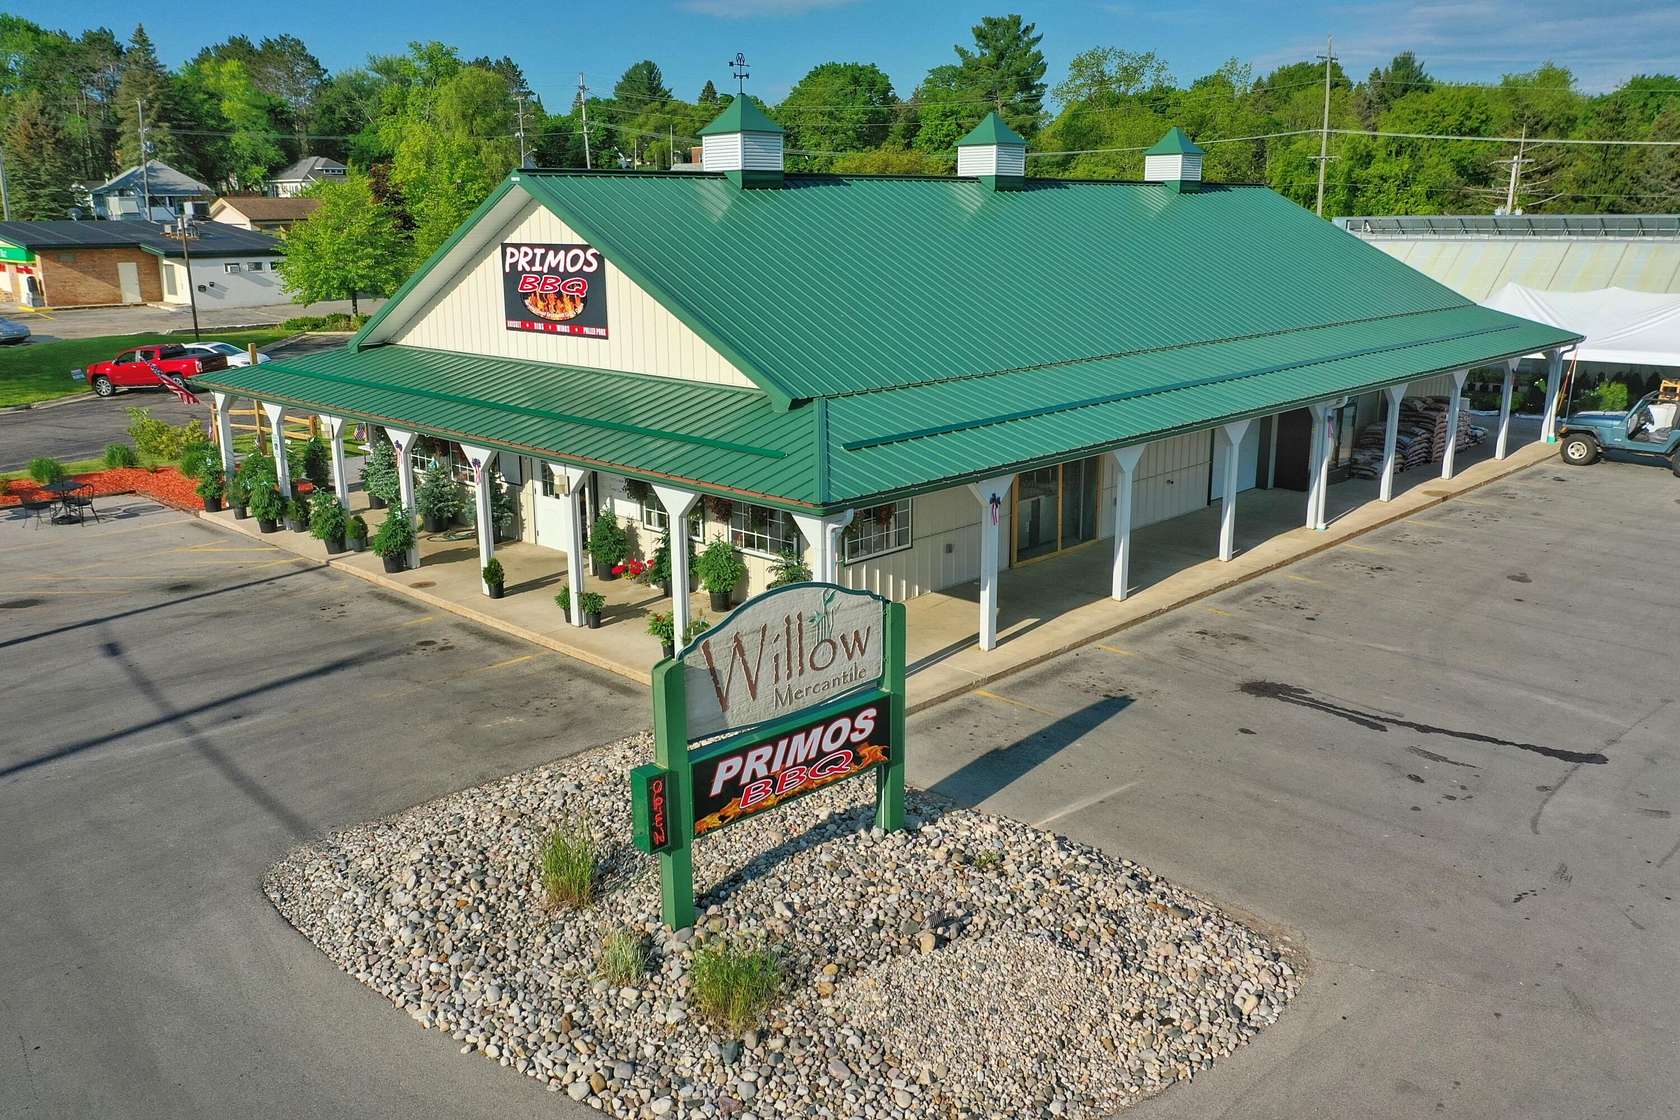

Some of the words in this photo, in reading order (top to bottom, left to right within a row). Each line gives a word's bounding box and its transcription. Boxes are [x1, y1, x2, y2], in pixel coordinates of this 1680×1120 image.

[505, 246, 600, 273] PRIMOS
[518, 274, 588, 297] BBQ
[701, 611, 871, 713] Willow
[774, 661, 867, 710] Mercantile
[709, 707, 878, 797] PRIMOS
[739, 749, 855, 809] BBQ
